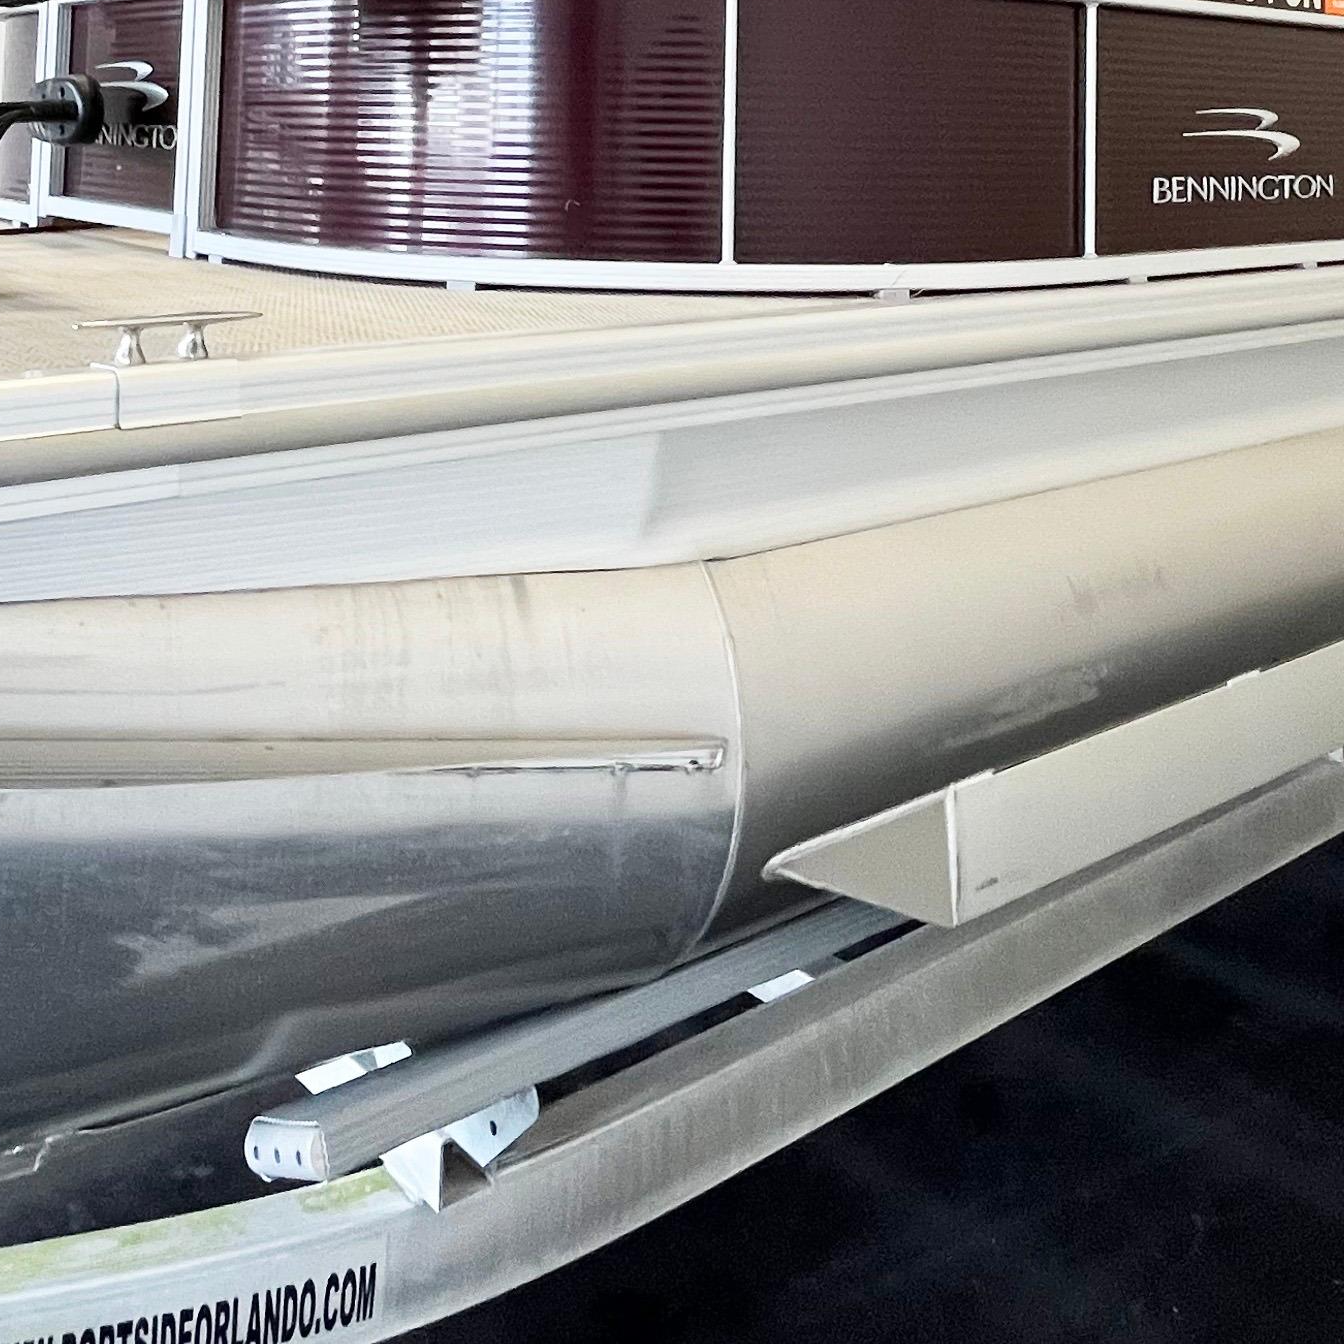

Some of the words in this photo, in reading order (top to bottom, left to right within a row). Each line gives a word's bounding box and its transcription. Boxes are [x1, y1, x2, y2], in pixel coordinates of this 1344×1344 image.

[94, 123, 177, 151] NINGTO
[1152, 174, 1334, 205] BENNINGTON
[12, 1262, 377, 1344] SIDEORLANDO.COM
